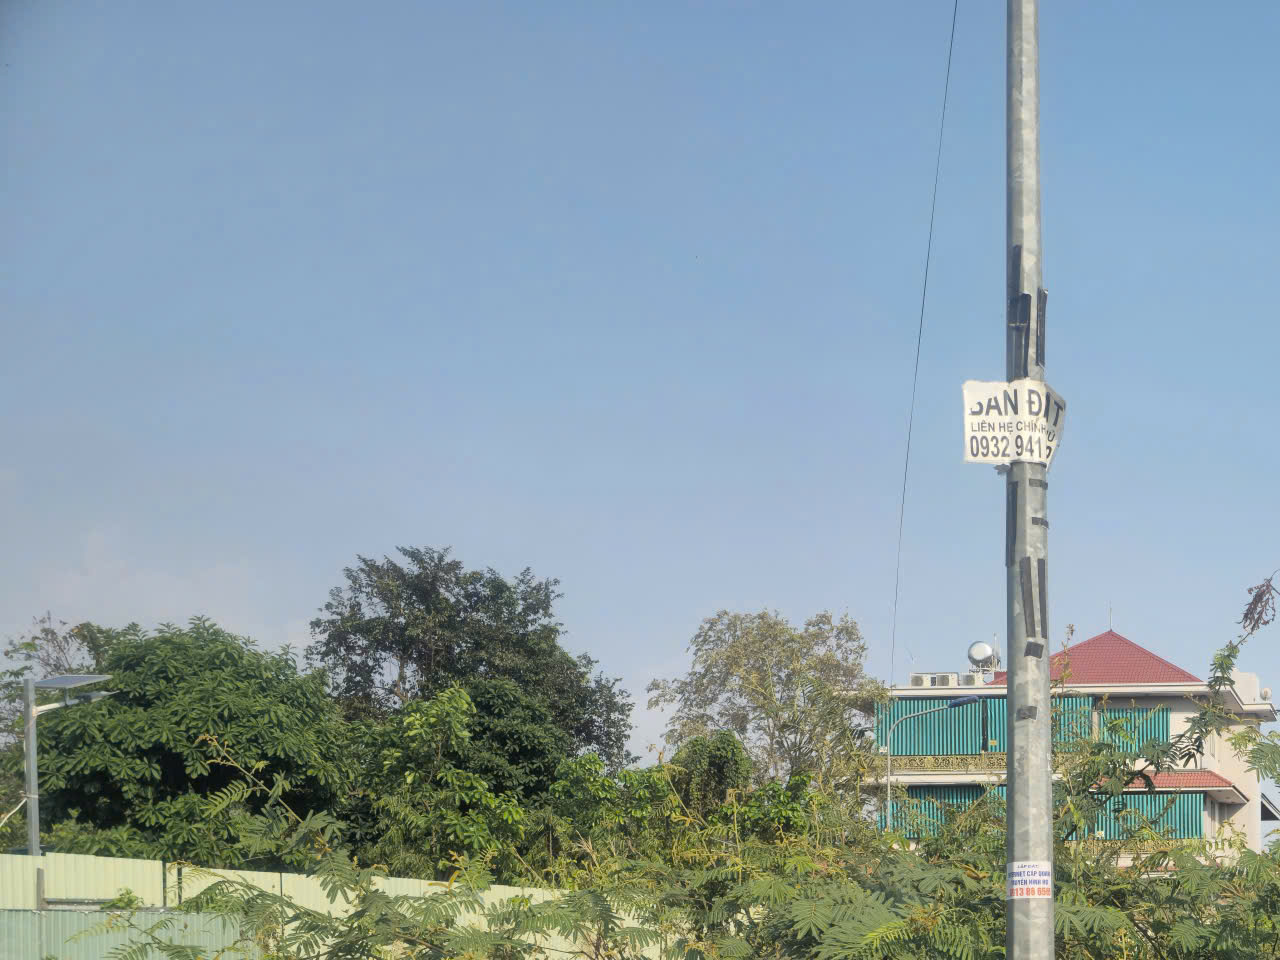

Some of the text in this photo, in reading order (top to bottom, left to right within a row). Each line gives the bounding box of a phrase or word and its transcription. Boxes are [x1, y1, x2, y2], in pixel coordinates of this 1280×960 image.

[971, 420, 995, 432] LIÊN
[999, 422, 1013, 435] HẸ
[970, 435, 1010, 458] 0932
